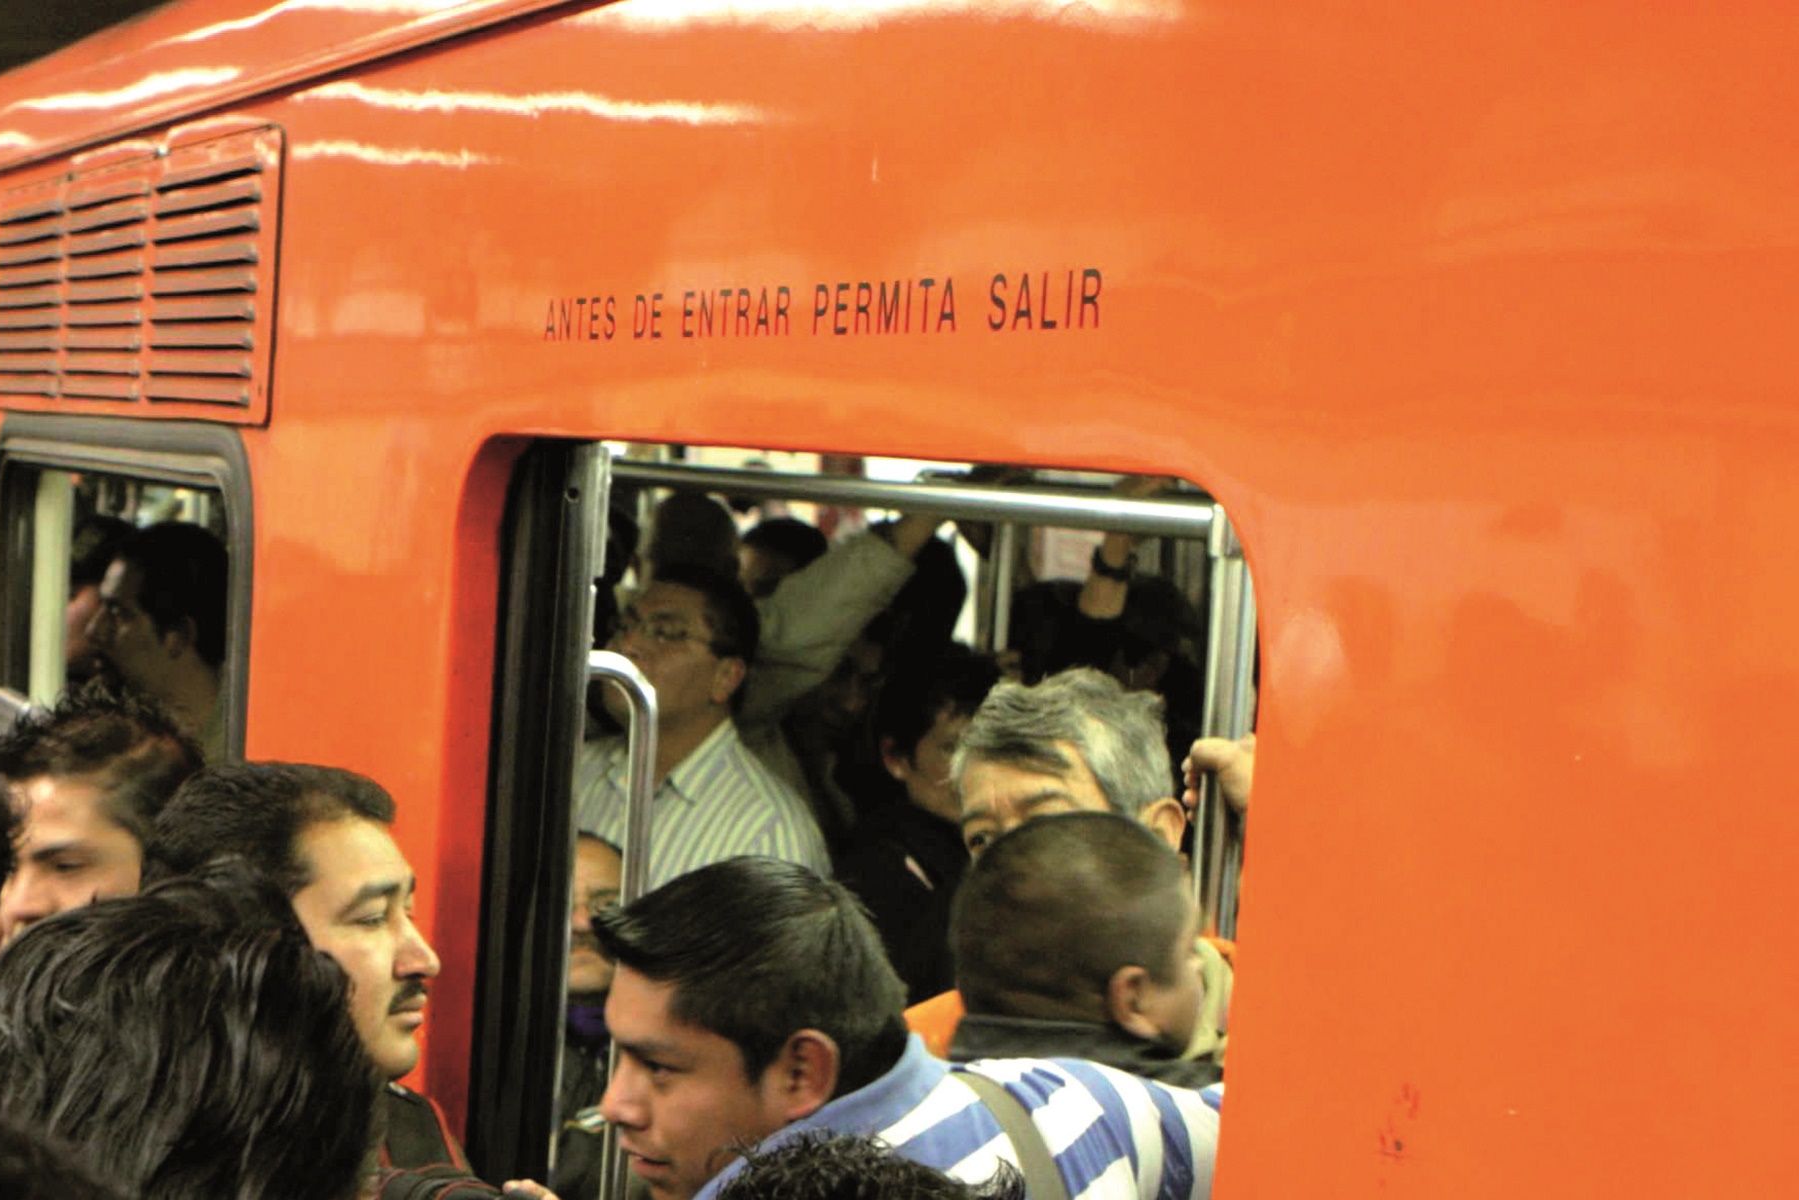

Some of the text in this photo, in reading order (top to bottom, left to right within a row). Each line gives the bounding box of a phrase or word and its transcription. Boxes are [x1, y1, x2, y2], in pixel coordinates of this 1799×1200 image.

[544, 268, 1102, 341] ANTES DE ENTRAR PERMITA SALIR
